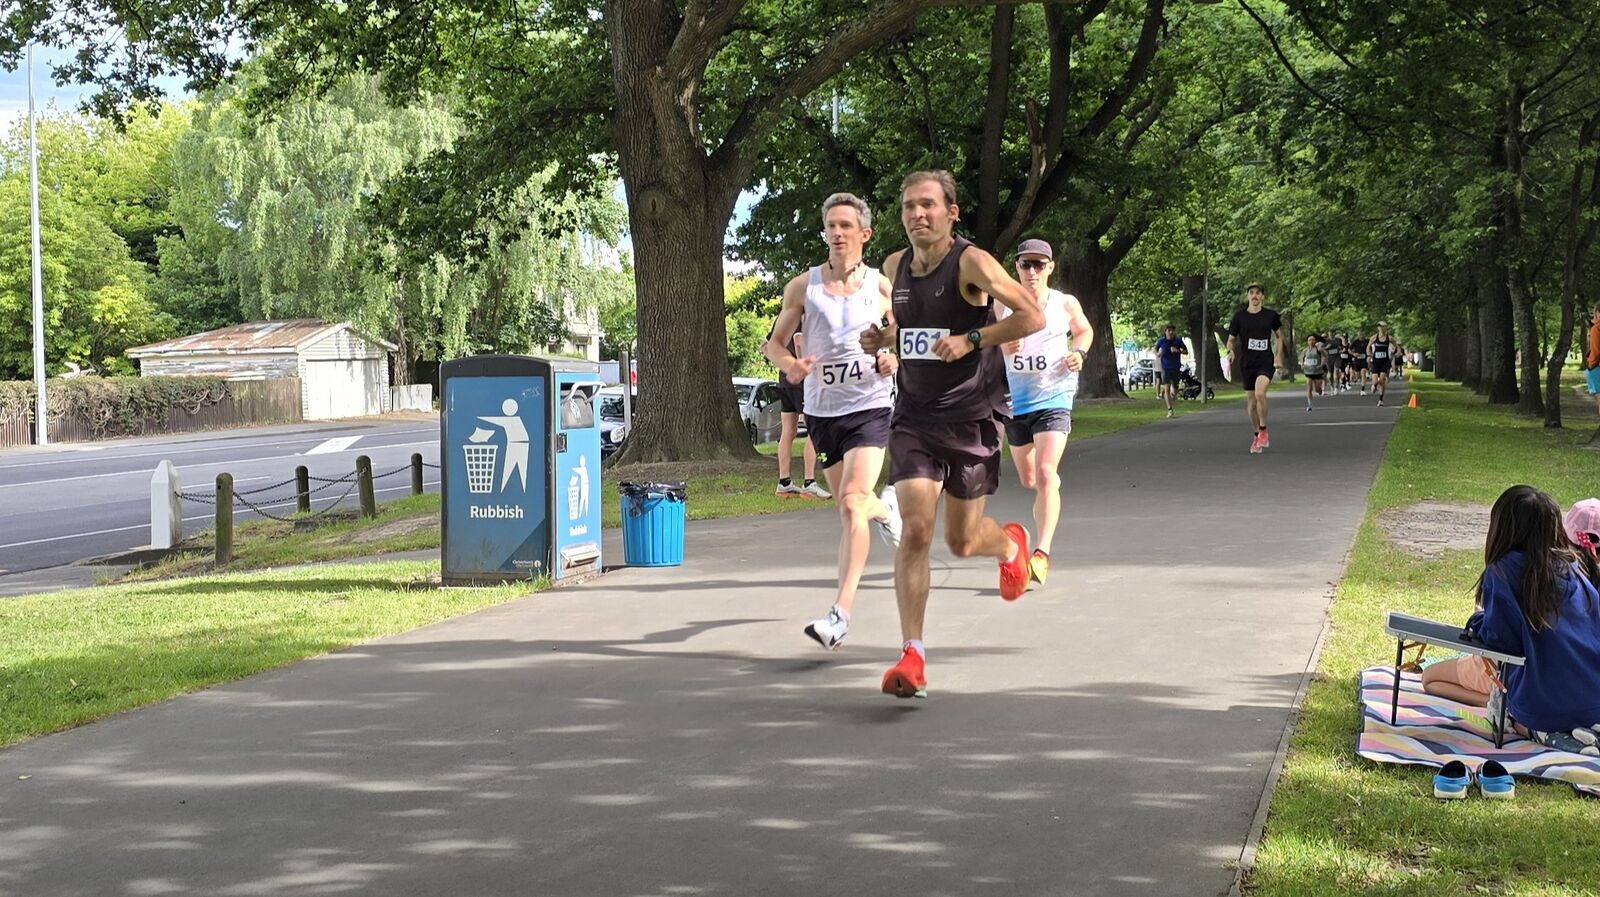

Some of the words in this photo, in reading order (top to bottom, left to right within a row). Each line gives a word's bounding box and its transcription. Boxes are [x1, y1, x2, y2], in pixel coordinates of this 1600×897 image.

[1250, 340, 1267, 349] 543
[1013, 355, 1047, 371] 518
[822, 360, 863, 385] 574
[470, 504, 524, 519] Rubbish
